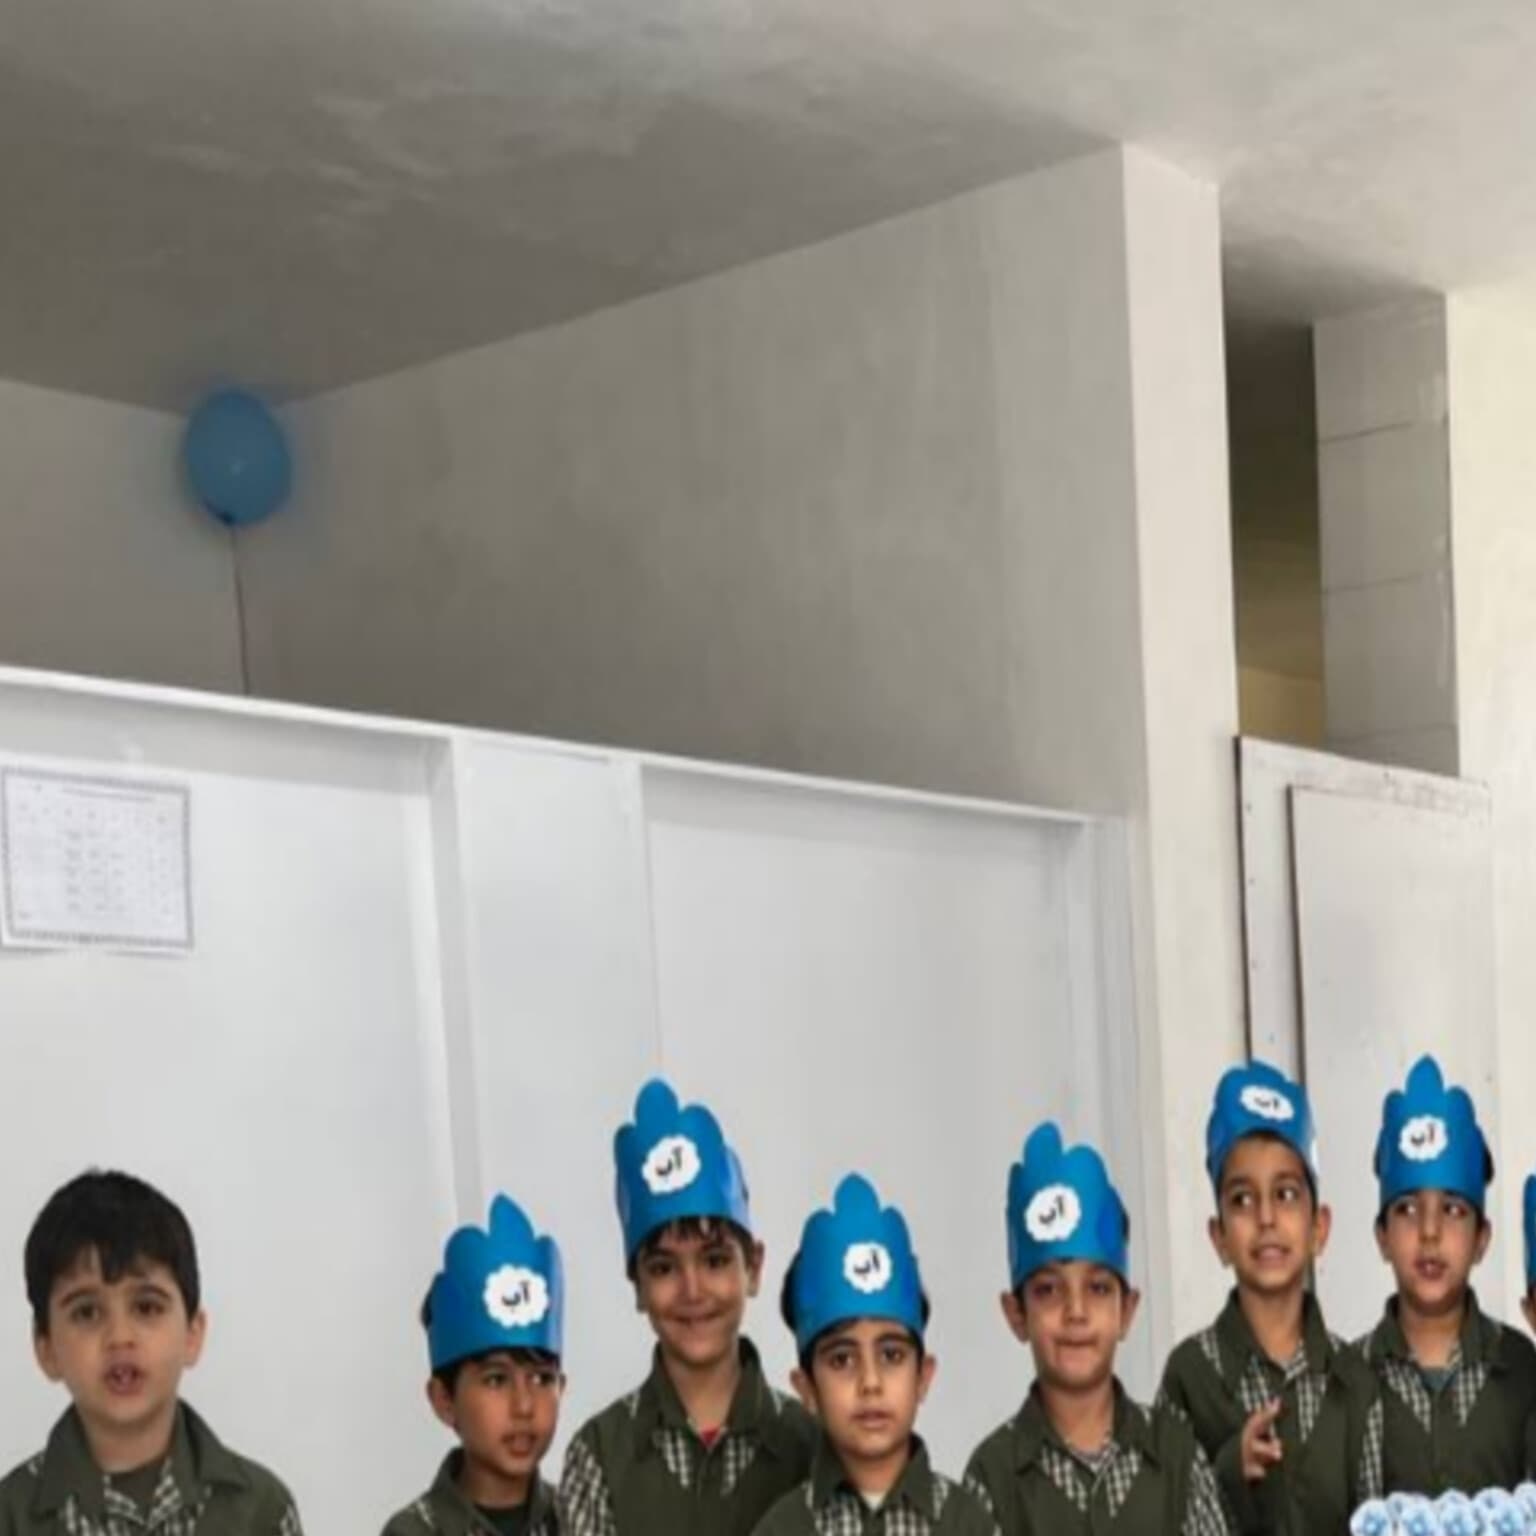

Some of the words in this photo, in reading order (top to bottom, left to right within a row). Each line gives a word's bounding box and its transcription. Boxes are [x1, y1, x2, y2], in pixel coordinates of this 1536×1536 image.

[655, 1146, 683, 1183] آب
[1038, 1194, 1064, 1226] آب
[501, 1279, 530, 1312] آب
